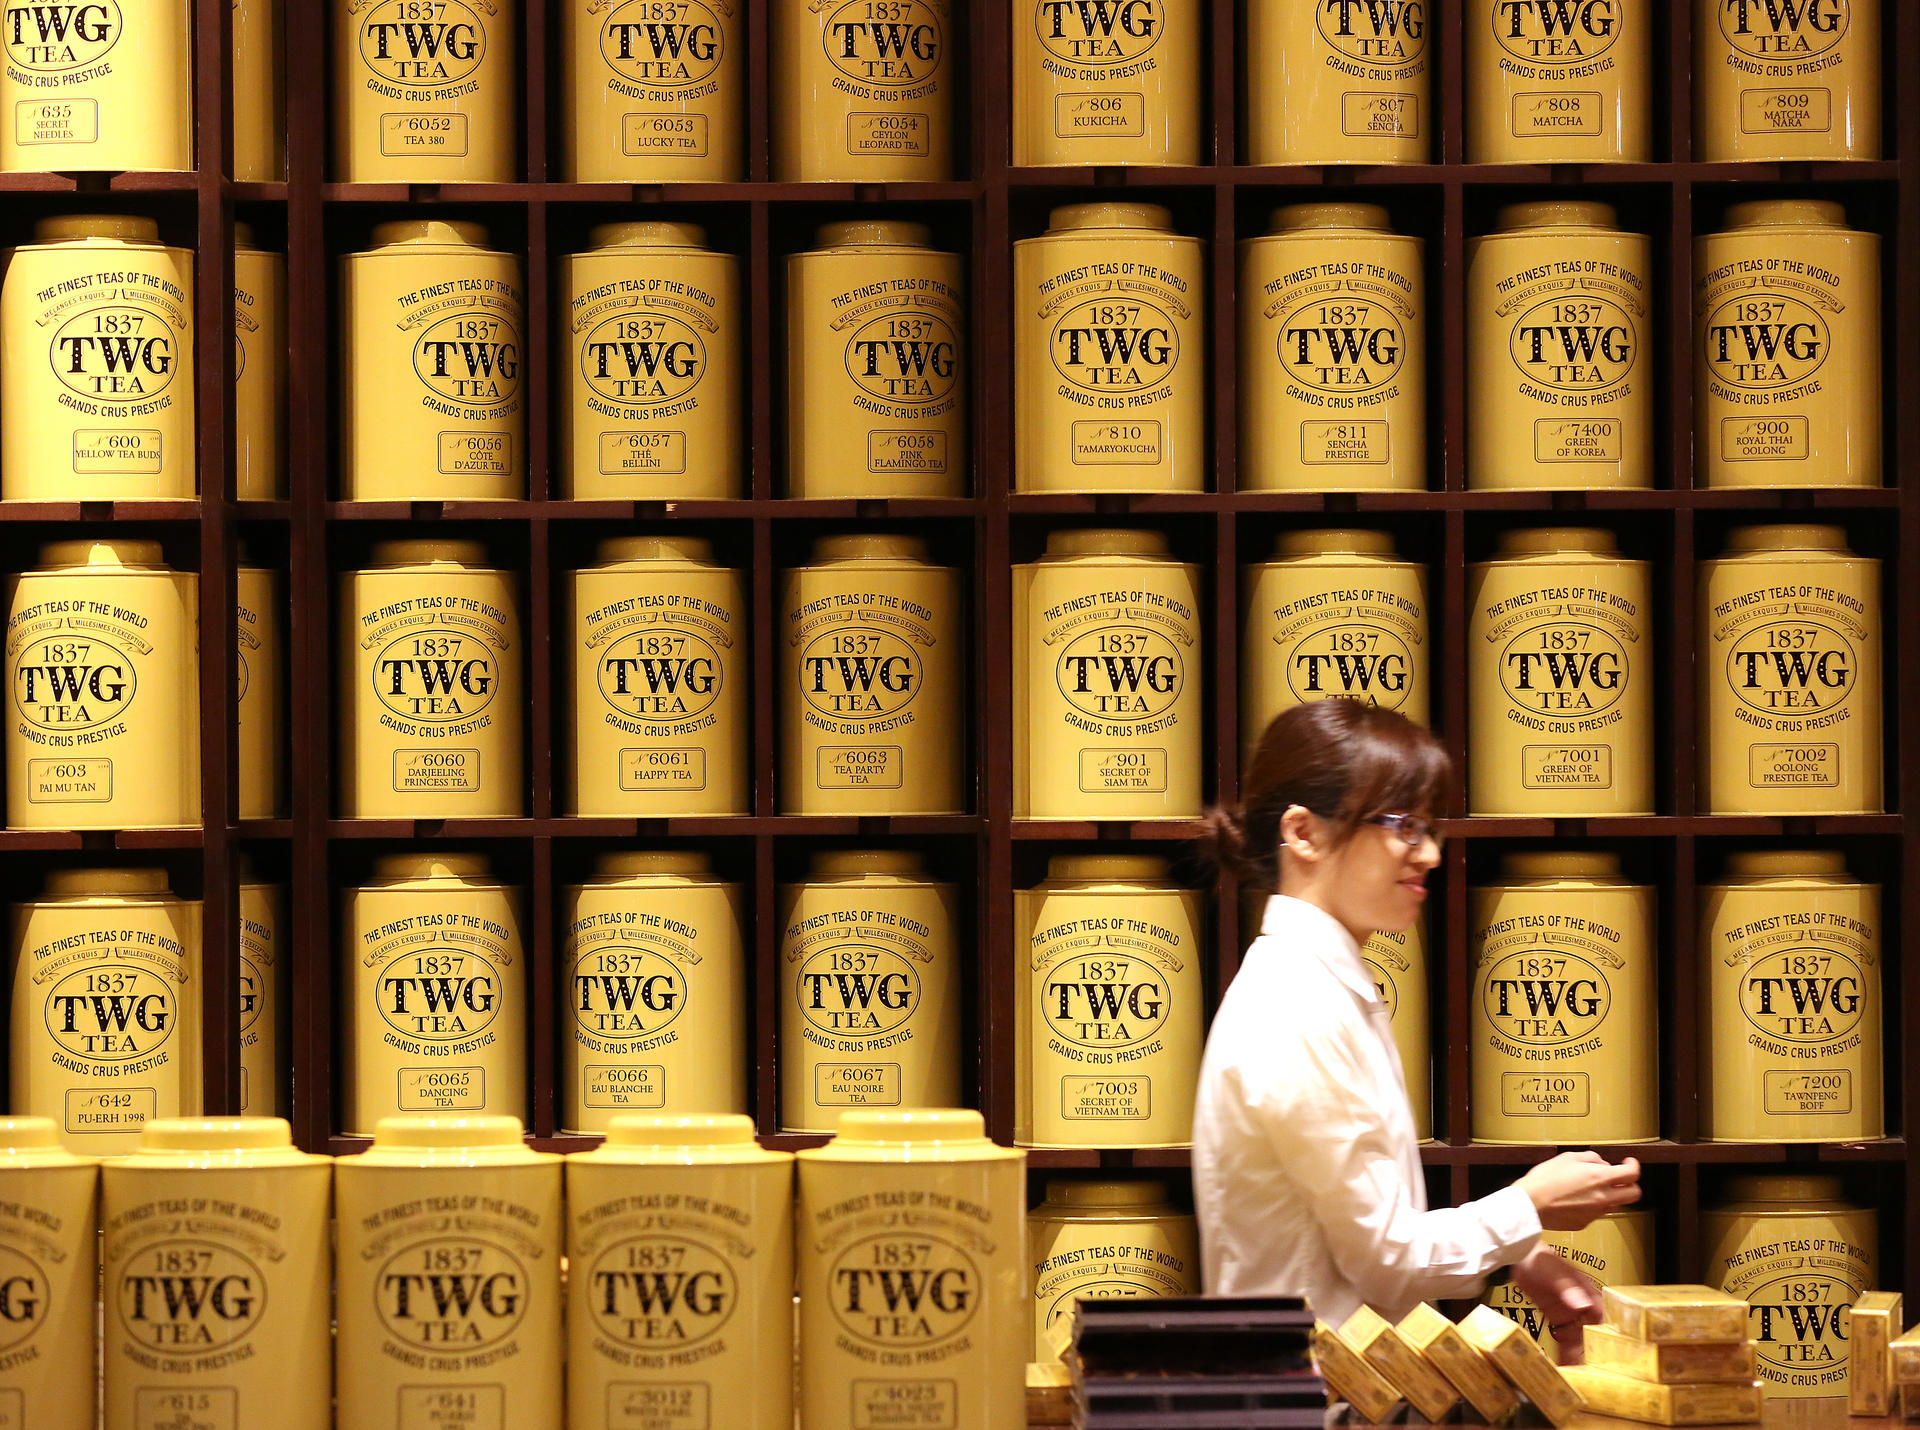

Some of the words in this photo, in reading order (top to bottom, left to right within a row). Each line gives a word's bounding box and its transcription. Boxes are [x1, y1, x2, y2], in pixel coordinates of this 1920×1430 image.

[1042, 1, 1155, 39] TWG
[1326, 0, 1424, 39] TWG
[1501, 0, 1612, 39] TWG
[1727, 0, 1839, 35] TWG
[6, 4, 113, 45] TWG
[367, 23, 476, 60] TWG
[608, 24, 718, 61] TWG
[832, 23, 936, 61] TWG
[1764, 111, 1810, 119] MATCHA
[36, 120, 69, 129] SECRET
[1074, 117, 1127, 126] KUKICHA
[1533, 117, 1583, 126] MATCHA
[1772, 119, 1802, 127] NARA
[33, 130, 74, 139] NEEDLES
[872, 131, 908, 139] CEYLON
[404, 136, 425, 144] TEA
[428, 136, 445, 144] 380
[638, 138, 674, 147] LUCKY
[677, 139, 697, 148] TEA
[859, 141, 902, 149] LEOPARD
[904, 142, 919, 150] TEA
[1058, 328, 1171, 366] TWG
[1286, 328, 1398, 366] TWG
[1520, 326, 1630, 364] TWG
[1711, 324, 1821, 363] TWG
[60, 337, 172, 375] TWG
[423, 341, 518, 378] TWG
[588, 341, 698, 380] TWG
[854, 341, 954, 379] TWG
[1327, 440, 1367, 448] SENCHA
[1565, 438, 1597, 446] GREEN
[1736, 437, 1766, 445] ROYAL
[1769, 436, 1792, 444] THAI
[1077, 445, 1156, 453] TAMARYOKUCHA
[1574, 448, 1606, 456] KOREA
[1742, 446, 1786, 455] OOLONG
[76, 450, 114, 458] YELLOW
[118, 450, 135, 458] TEA
[138, 451, 160, 459] BUDS
[469, 450, 493, 460] CÔTE
[900, 451, 922, 459] PINK
[455, 461, 489, 469] D'AZUR
[491, 462, 505, 470] TEA
[622, 459, 661, 467] BELLINI
[875, 459, 926, 468] FLAMINGO
[928, 460, 943, 468] TEA
[806, 656, 916, 695] TWG
[1065, 656, 1177, 693] TWG
[1296, 655, 1407, 693] TWG
[1509, 652, 1622, 691] TWG
[1736, 651, 1849, 690] TWG
[381, 660, 490, 698] TWG
[606, 657, 716, 695] TWG
[19, 664, 127, 705] TWG
[834, 766, 853, 774] TEA
[855, 766, 886, 774] PARTY
[1100, 768, 1136, 776] SECRET
[1138, 768, 1151, 776] OF
[1543, 765, 1576, 773] GREEN
[1578, 765, 1592, 773] OF
[1773, 763, 1818, 771] OOLONG
[408, 768, 465, 778] DARJEELING
[634, 771, 669, 779] HAPPY
[672, 771, 692, 779] TEA
[1764, 774, 1809, 782] PRESTIGE
[1811, 774, 1828, 782] TEA
[405, 778, 448, 787] PRINCESS
[452, 779, 469, 787] TEA
[850, 775, 869, 783] TEA
[1104, 778, 1128, 787] SIAM
[1131, 778, 1148, 787] TEA
[1535, 774, 1580, 783] VIETNAM
[1583, 774, 1600, 782] TEA
[40, 784, 53, 792] PAI
[55, 784, 71, 792] MU
[74, 783, 96, 791] TAN
[384, 978, 494, 1016] TWG
[575, 974, 678, 1014] TWG
[803, 973, 913, 1012] TWG
[1748, 978, 1861, 1016] TWG
[1050, 982, 1163, 1021] TWG
[1491, 980, 1599, 1018] TWG
[54, 994, 169, 1033] TWG
[420, 1088, 468, 1097] DANCING
[591, 1085, 608, 1093] EAU
[610, 1085, 653, 1093] BLANCHE
[832, 1085, 851, 1093] EAU
[853, 1085, 884, 1093] NOIRE
[848, 1094, 866, 1102] TEA
[1521, 1095, 1570, 1103] MALABAR
[1784, 1092, 1838, 1100] TAWNPENG
[434, 1097, 454, 1106] TEA
[1080, 1098, 1117, 1106] SECRET
[1119, 1098, 1132, 1106] OF
[1075, 1107, 1119, 1115] VIETNAM
[1122, 1107, 1139, 1115] TEA
[1538, 1103, 1552, 1112] OP
[78, 1114, 119, 1123] PU-ERH
[124, 1114, 145, 1122] 1998
[627, 1246, 685, 1268] 1837
[872, 1244, 932, 1265] 1837
[156, 1251, 214, 1273] 1837
[423, 1249, 484, 1271] 1837
[595, 1271, 727, 1315] TWG
[837, 1269, 971, 1313] TWG
[1781, 1282, 1832, 1302] 1837
[125, 1276, 256, 1321] TWG
[385, 1274, 520, 1319] TWG
[150, 1323, 214, 1344] TEA
[415, 1321, 482, 1343] TEA
[622, 1318, 687, 1339] TEA
[1779, 1344, 1836, 1361] TEA
